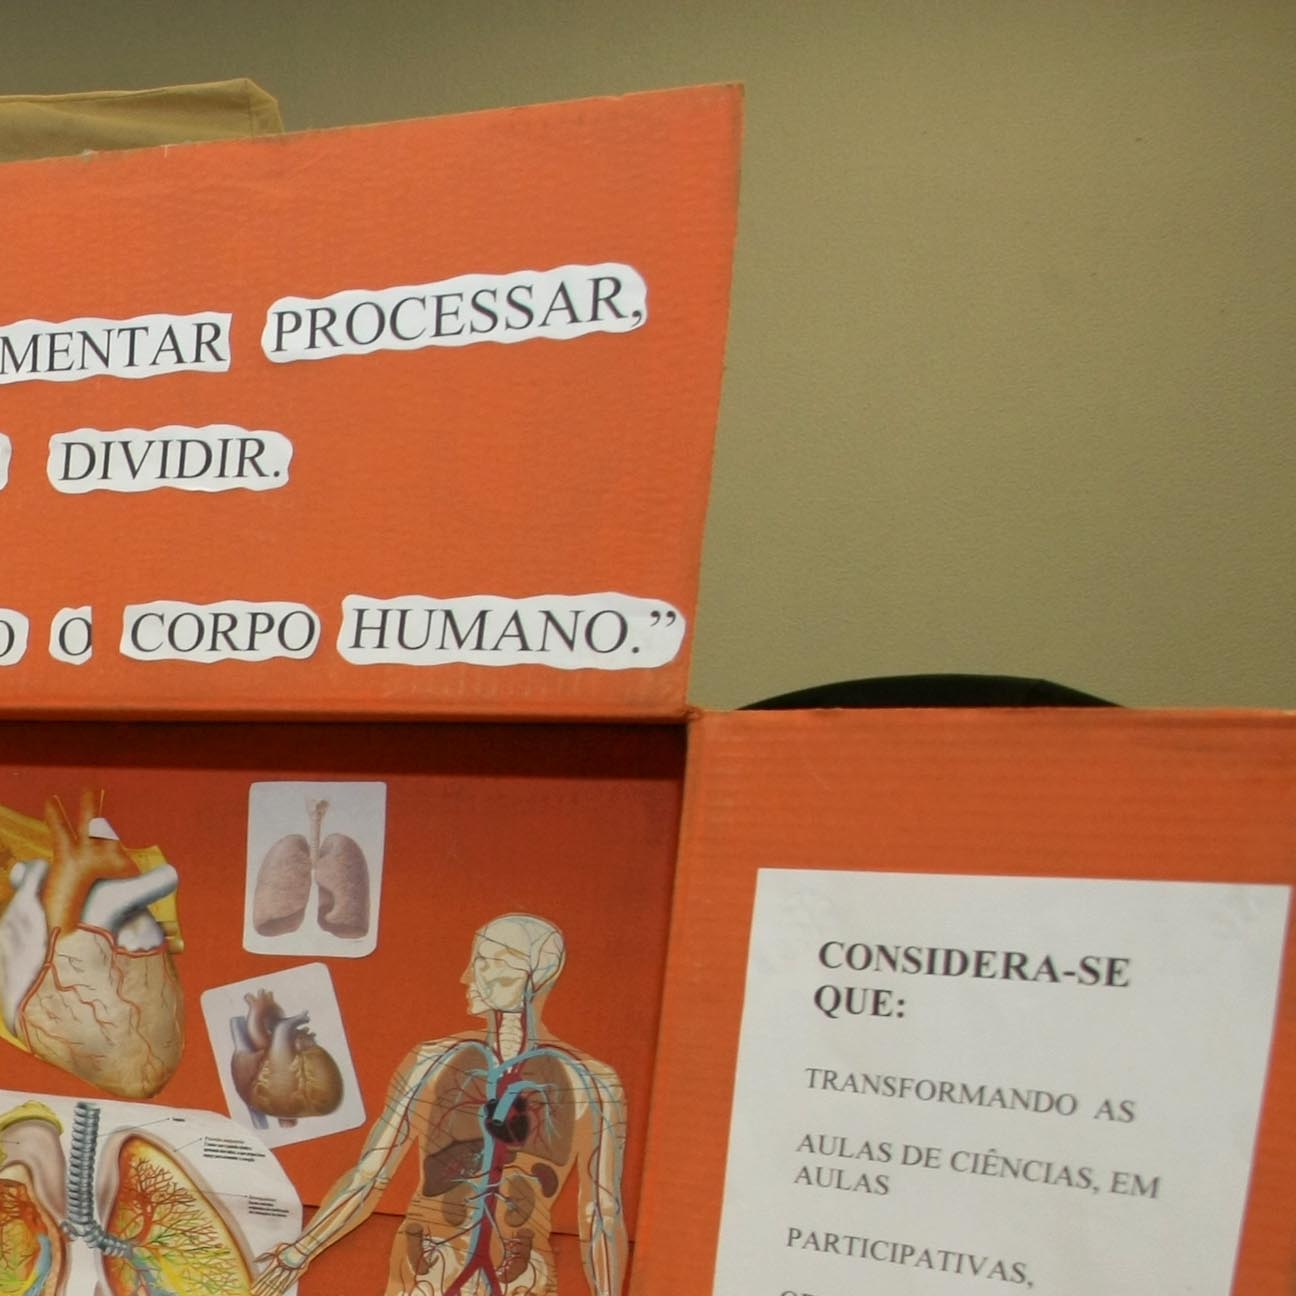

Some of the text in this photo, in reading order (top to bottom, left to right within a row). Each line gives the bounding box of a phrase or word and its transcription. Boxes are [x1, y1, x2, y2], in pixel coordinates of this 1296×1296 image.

[272, 274, 643, 355] PROCESSAR,
[59, 436, 282, 481] DIVIDIR.
[58, 620, 92, 658] O
[130, 610, 316, 654] CORPO
[818, 941, 1130, 988] CONSIDERA-SE
[813, 985, 905, 1019] QUE:
[806, 1067, 1136, 1124] TRANSFORMANDO AS
[794, 1166, 890, 1196] AULAS
[796, 1133, 1161, 1199] AULAS DE CIÊNCIAS, EM
[786, 1227, 1034, 1289] PARTICIPATIVAS,
